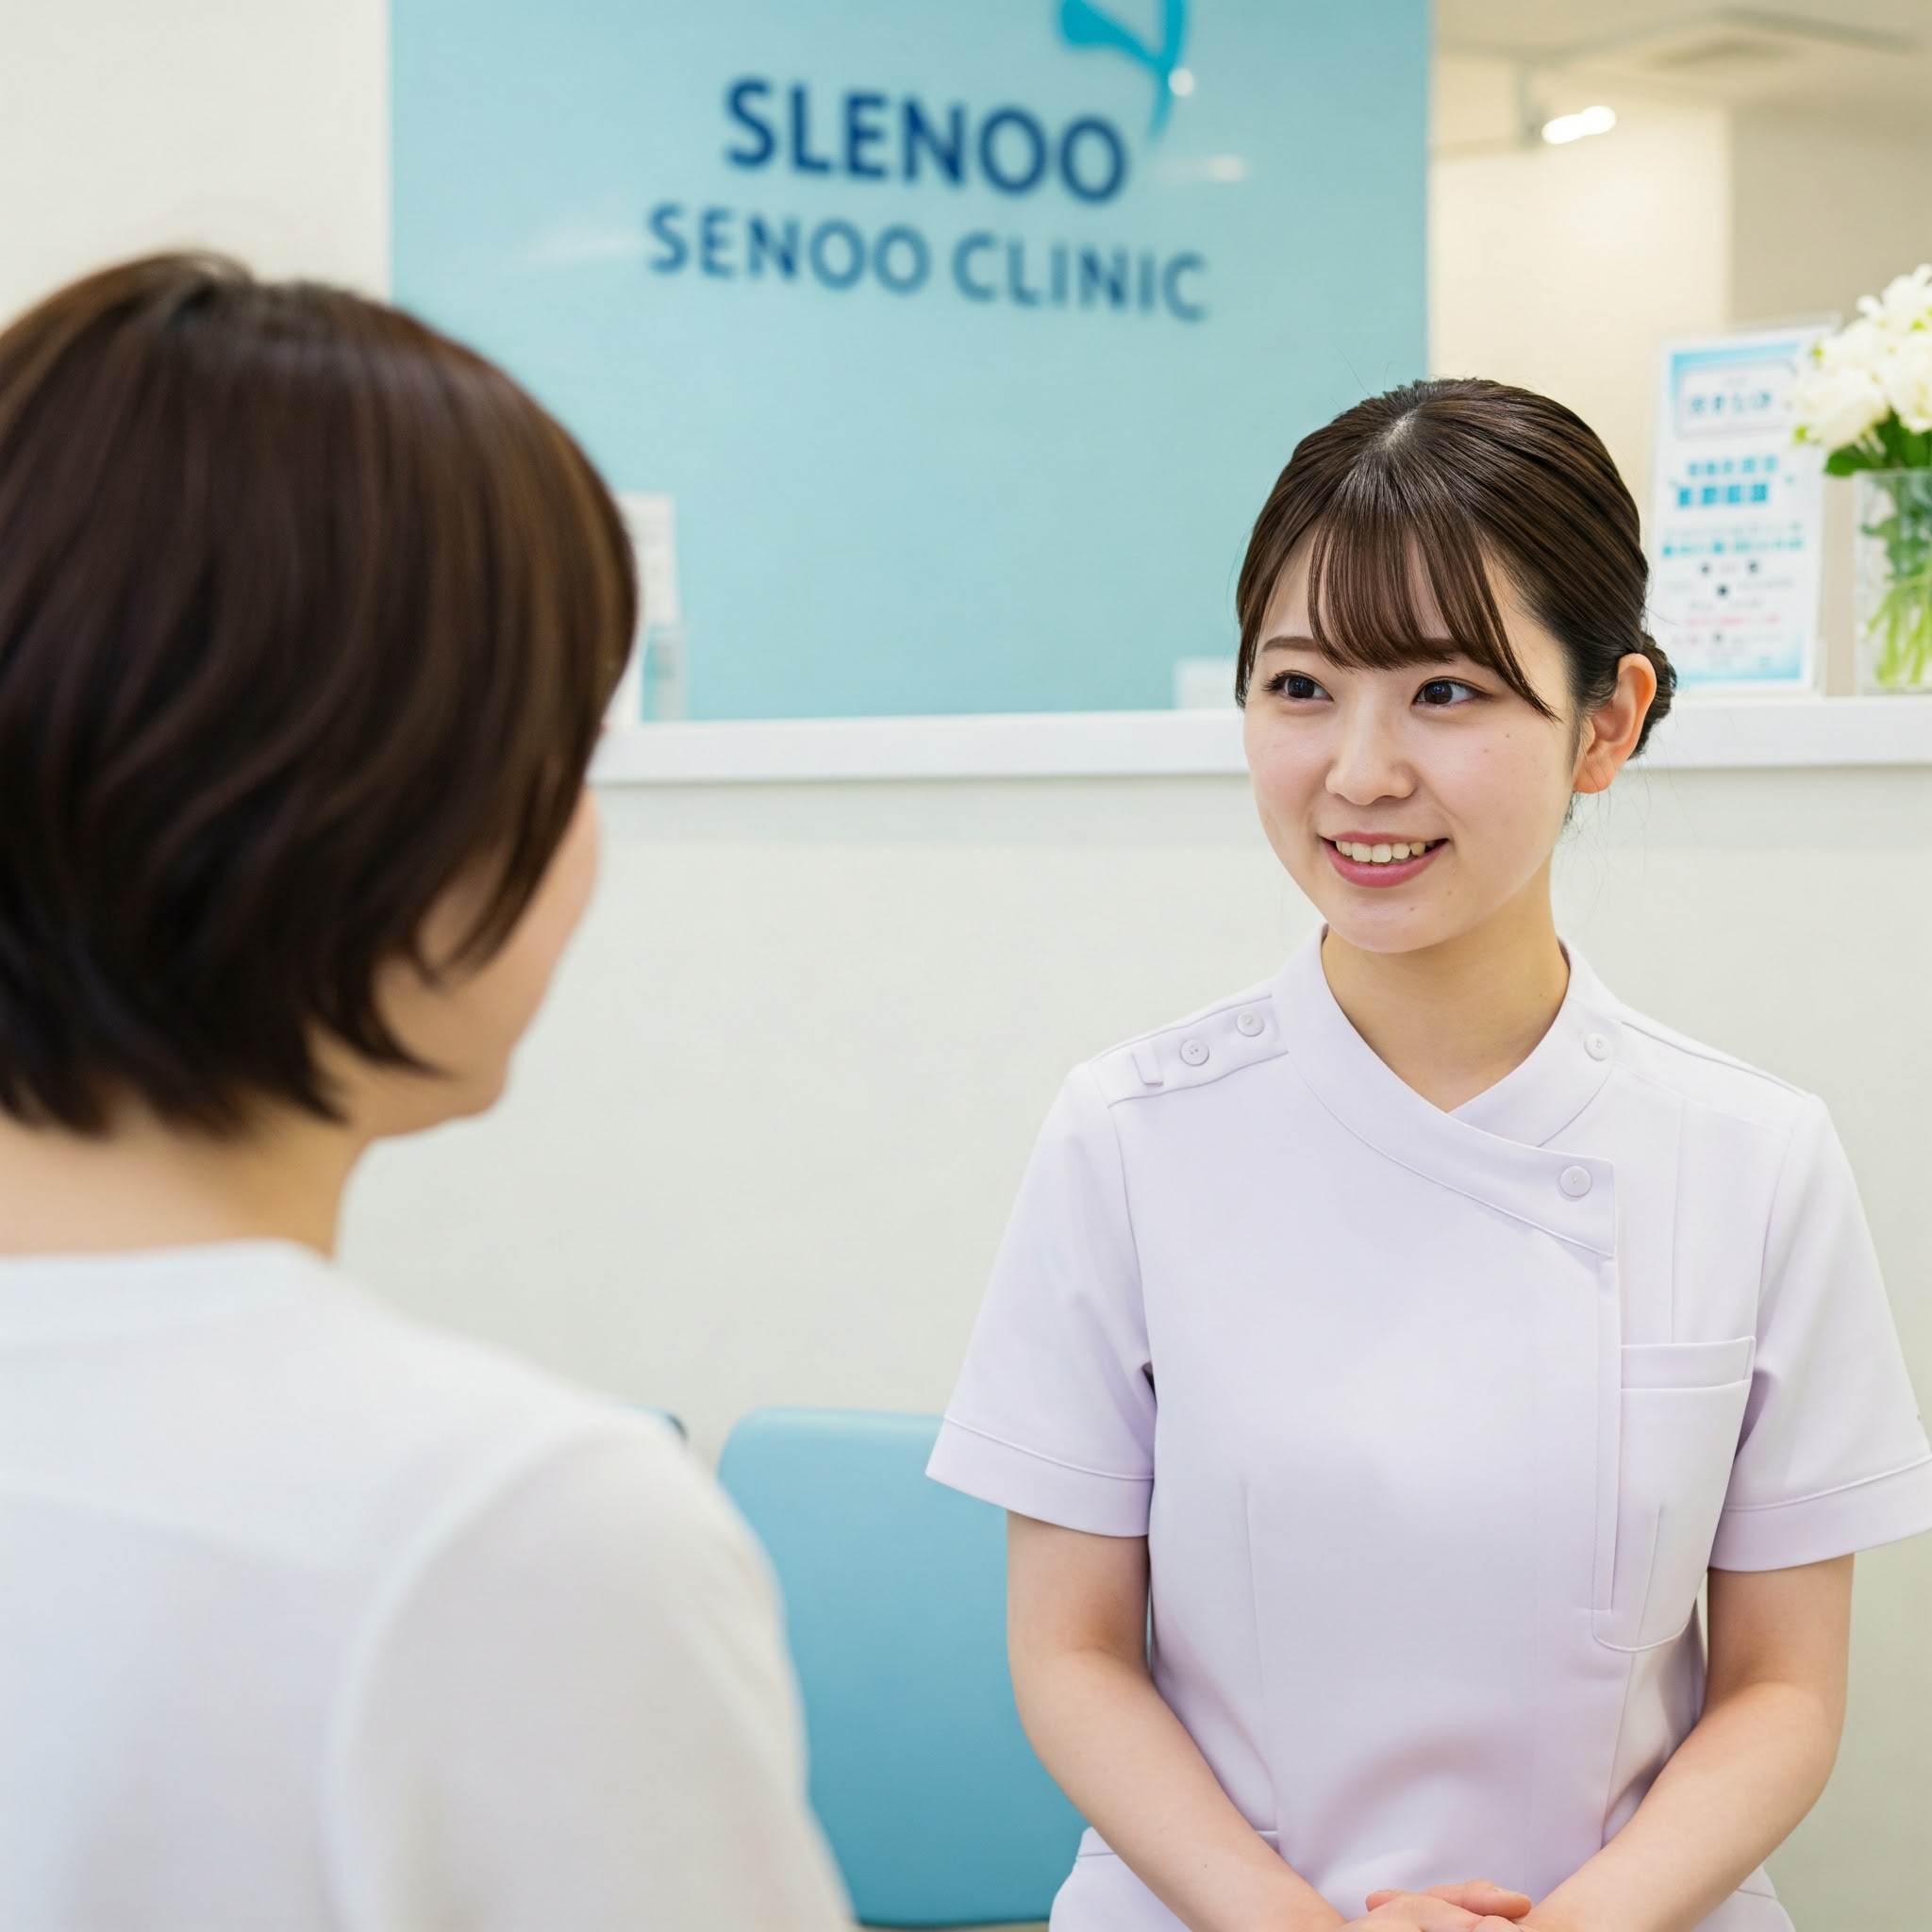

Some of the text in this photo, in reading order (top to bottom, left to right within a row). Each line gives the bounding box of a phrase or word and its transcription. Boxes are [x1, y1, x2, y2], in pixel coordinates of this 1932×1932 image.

[724, 76, 1127, 202] SLENOO
[649, 203, 1208, 322] SENOO CLINIC
